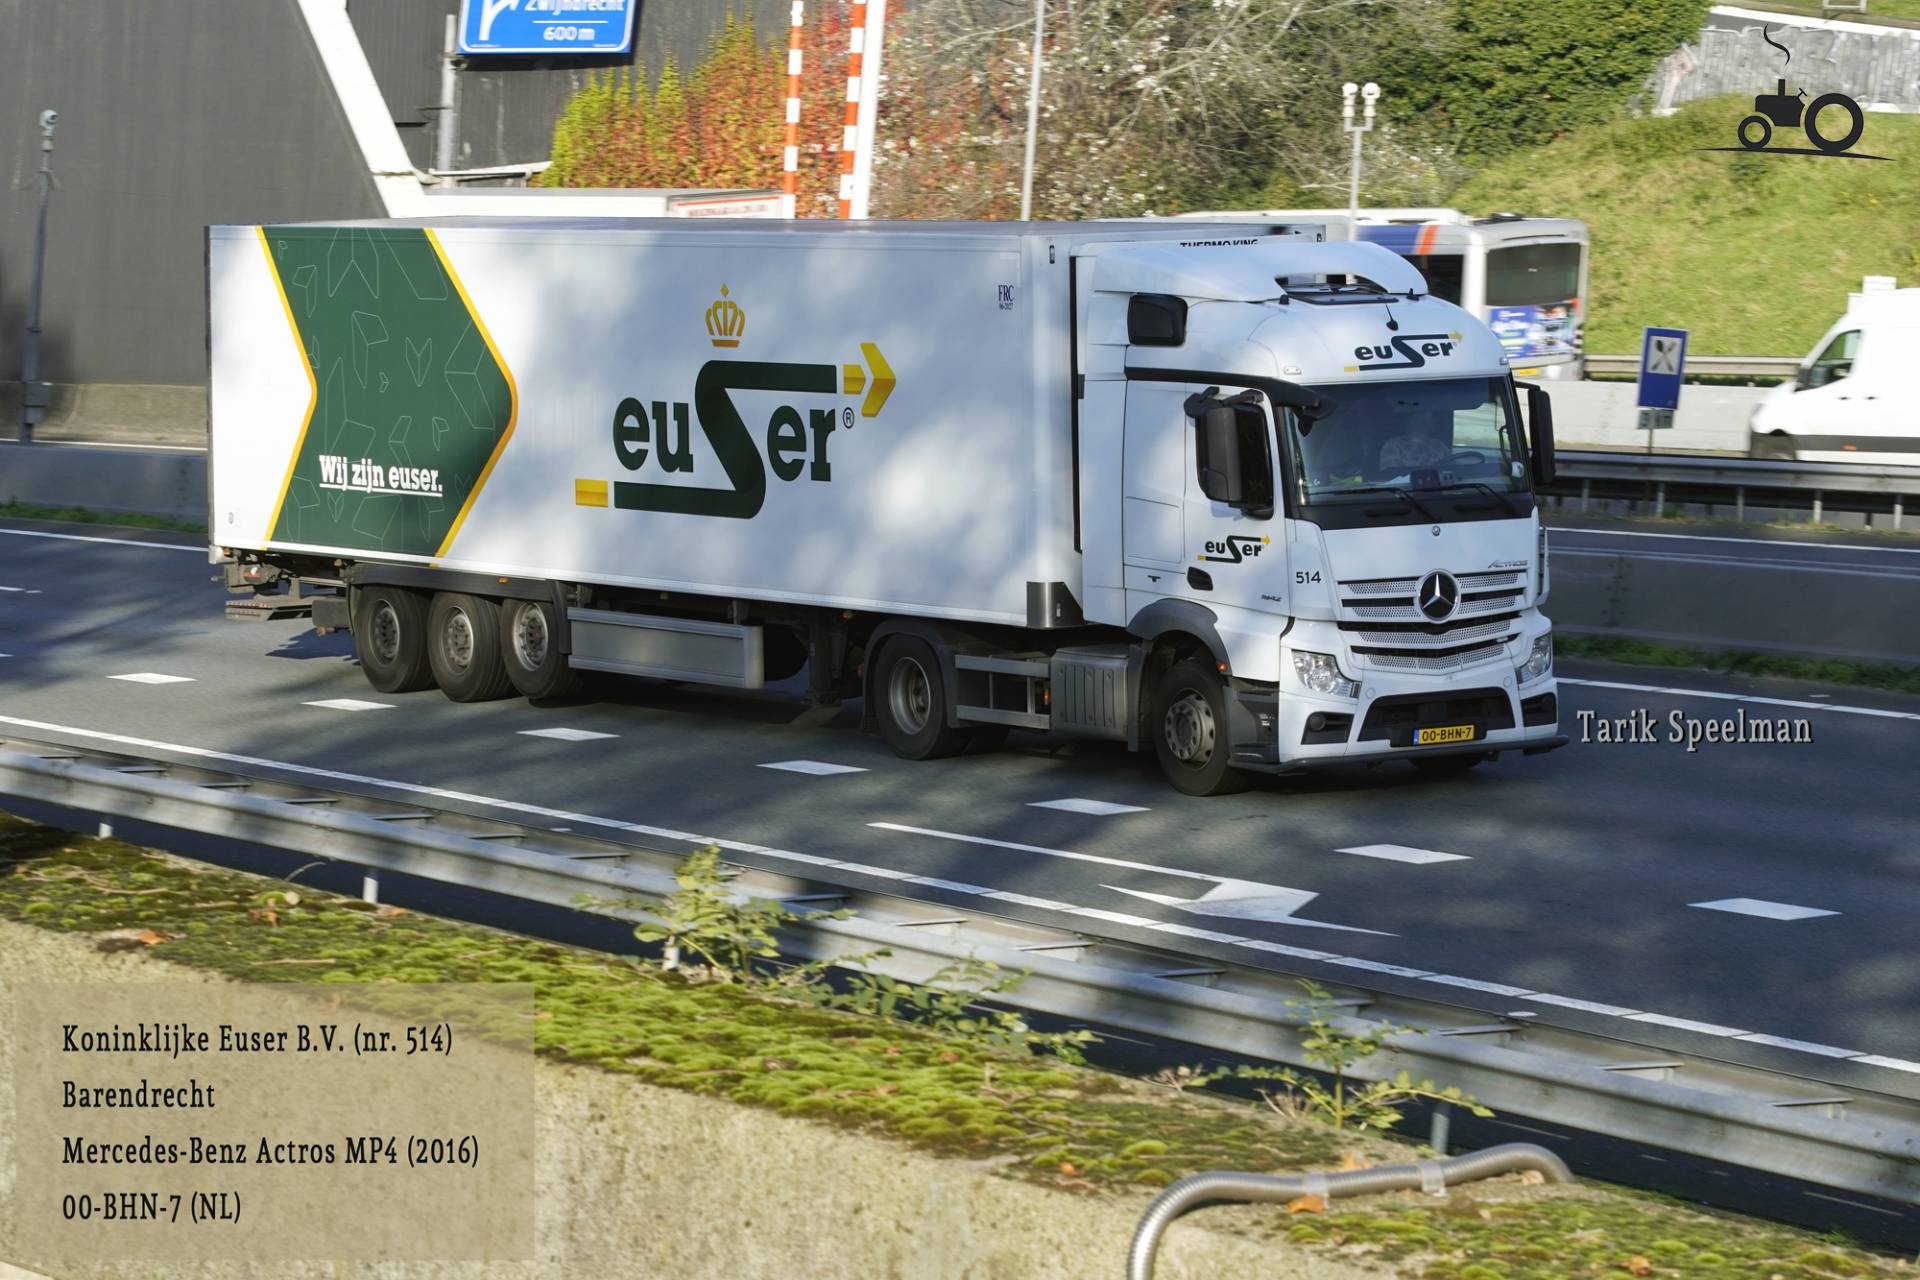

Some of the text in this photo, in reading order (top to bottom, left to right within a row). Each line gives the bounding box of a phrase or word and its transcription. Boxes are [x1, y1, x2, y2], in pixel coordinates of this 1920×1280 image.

[998, 285, 1015, 302] FRC
[319, 455, 443, 493] Wij zijn euser.
[1296, 570, 1322, 585] 514
[1421, 727, 1473, 743] 00-BHN-7
